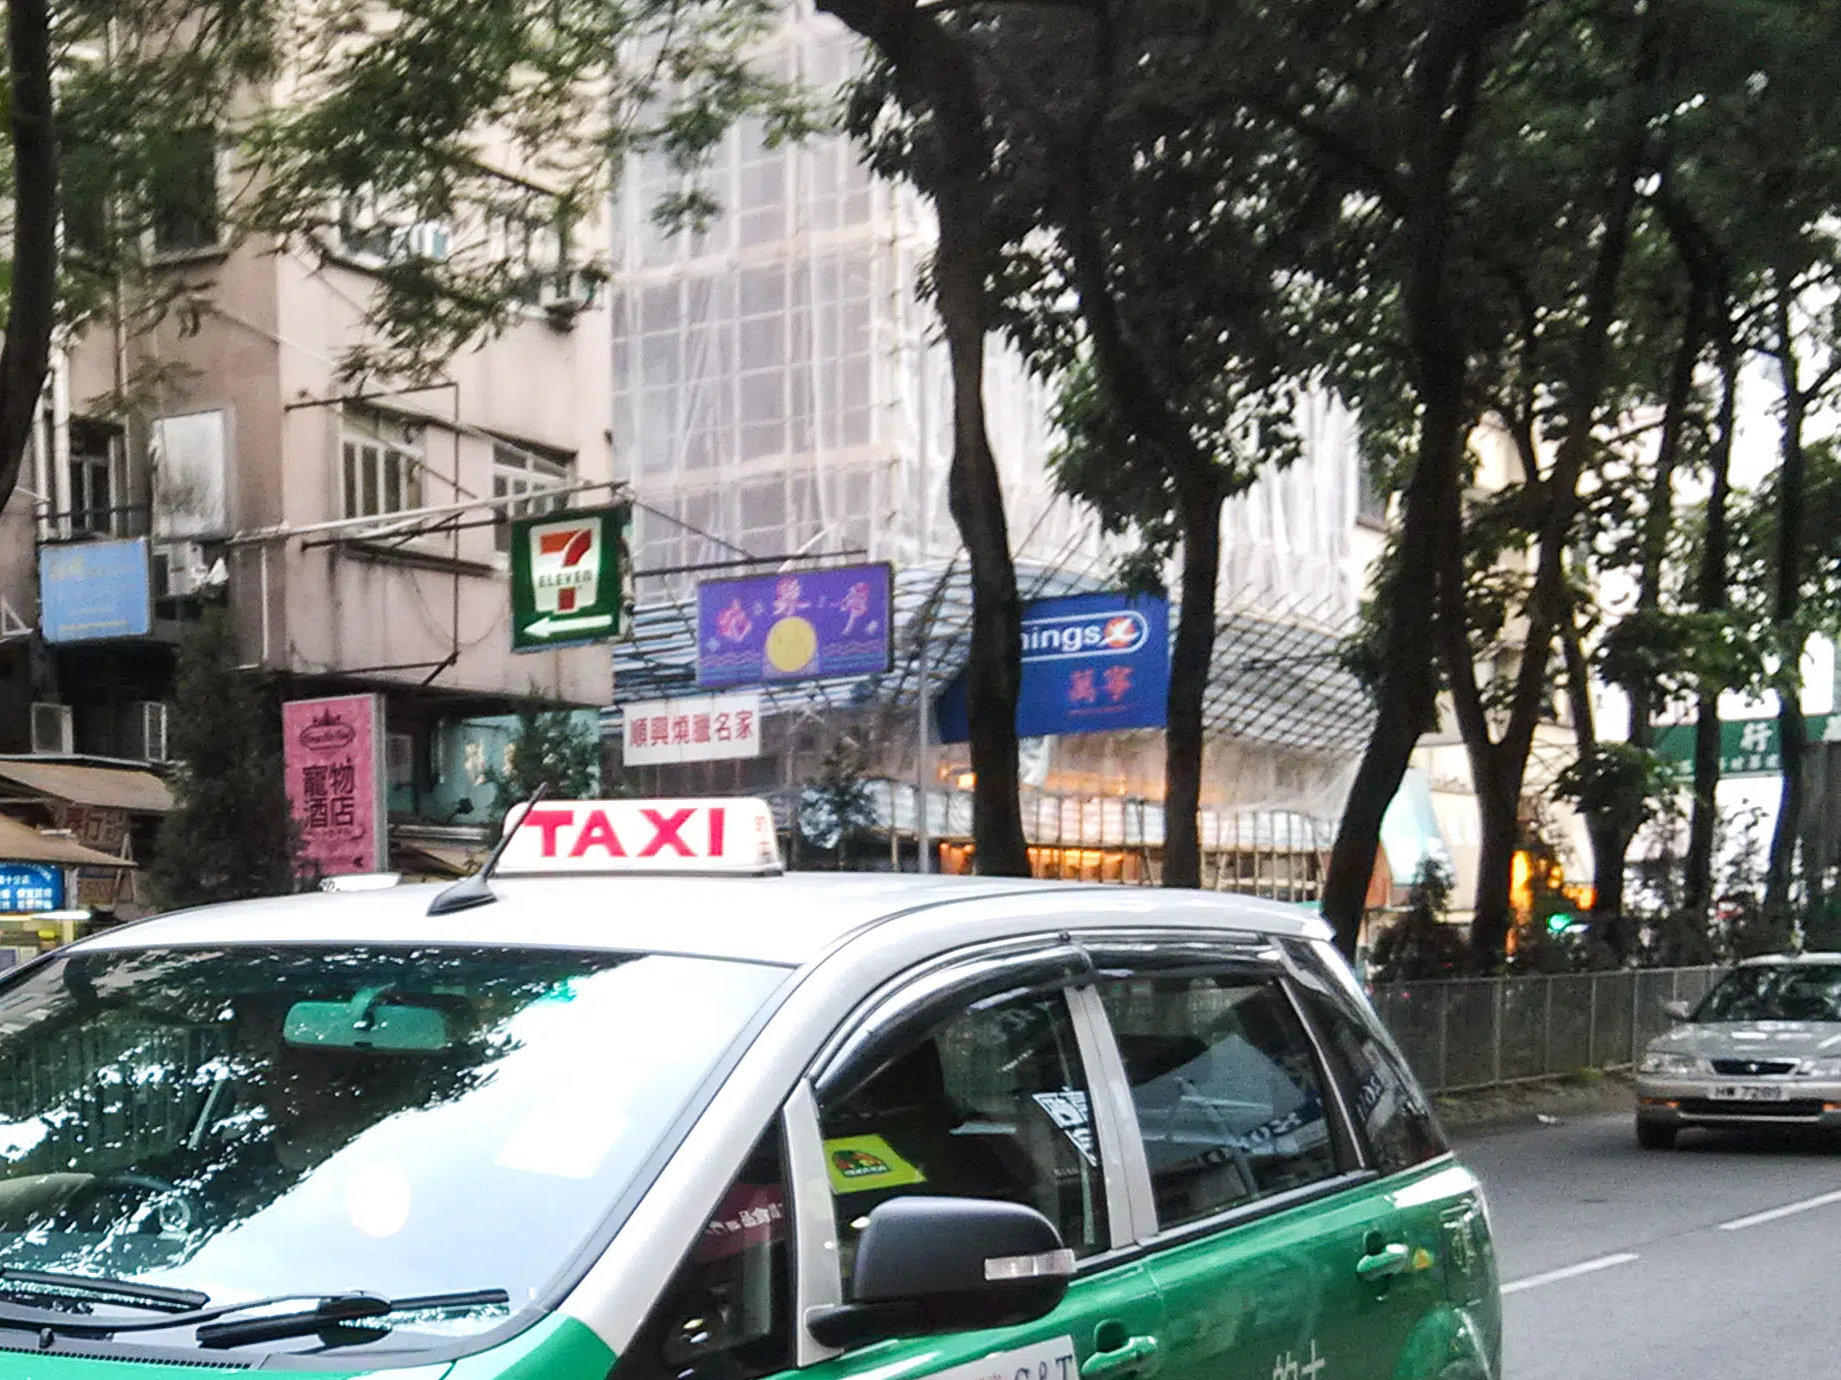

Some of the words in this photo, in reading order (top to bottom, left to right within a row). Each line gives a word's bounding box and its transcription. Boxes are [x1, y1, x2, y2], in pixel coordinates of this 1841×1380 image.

[539, 528, 592, 612] 7
[302, 755, 355, 796] 寵物
[303, 796, 355, 829] 酒店
[522, 807, 725, 858] TAXI
